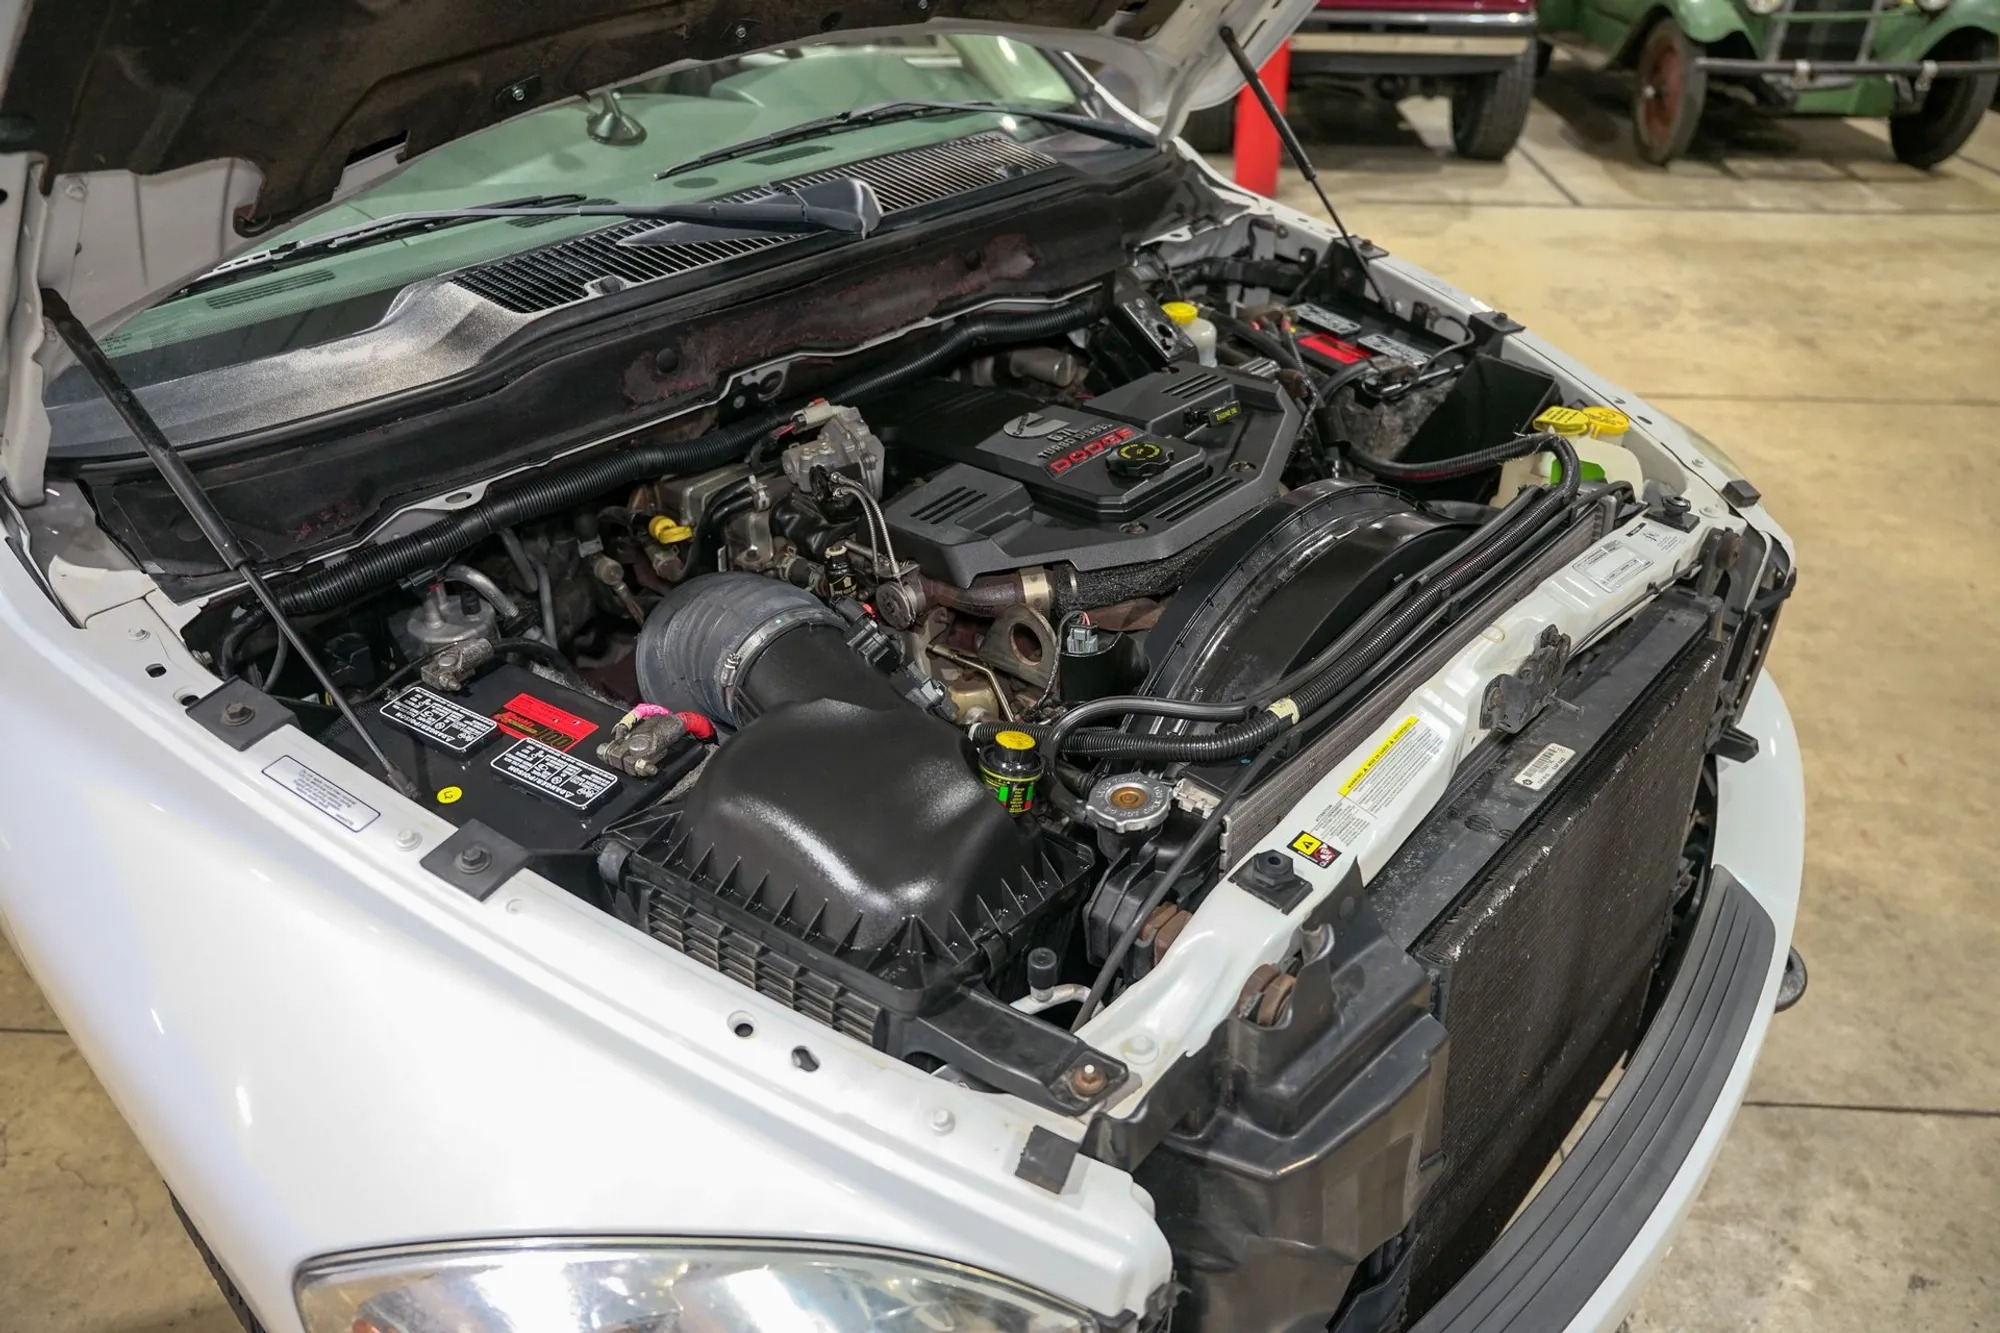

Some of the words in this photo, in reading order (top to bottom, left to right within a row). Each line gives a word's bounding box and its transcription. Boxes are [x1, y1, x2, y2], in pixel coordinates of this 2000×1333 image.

[1046, 427, 1079, 442] 6.7L
[1048, 426, 1136, 473] DODGE
[395, 711, 450, 739] DANGER/POISON
[507, 765, 567, 795] DANGER/POISON
